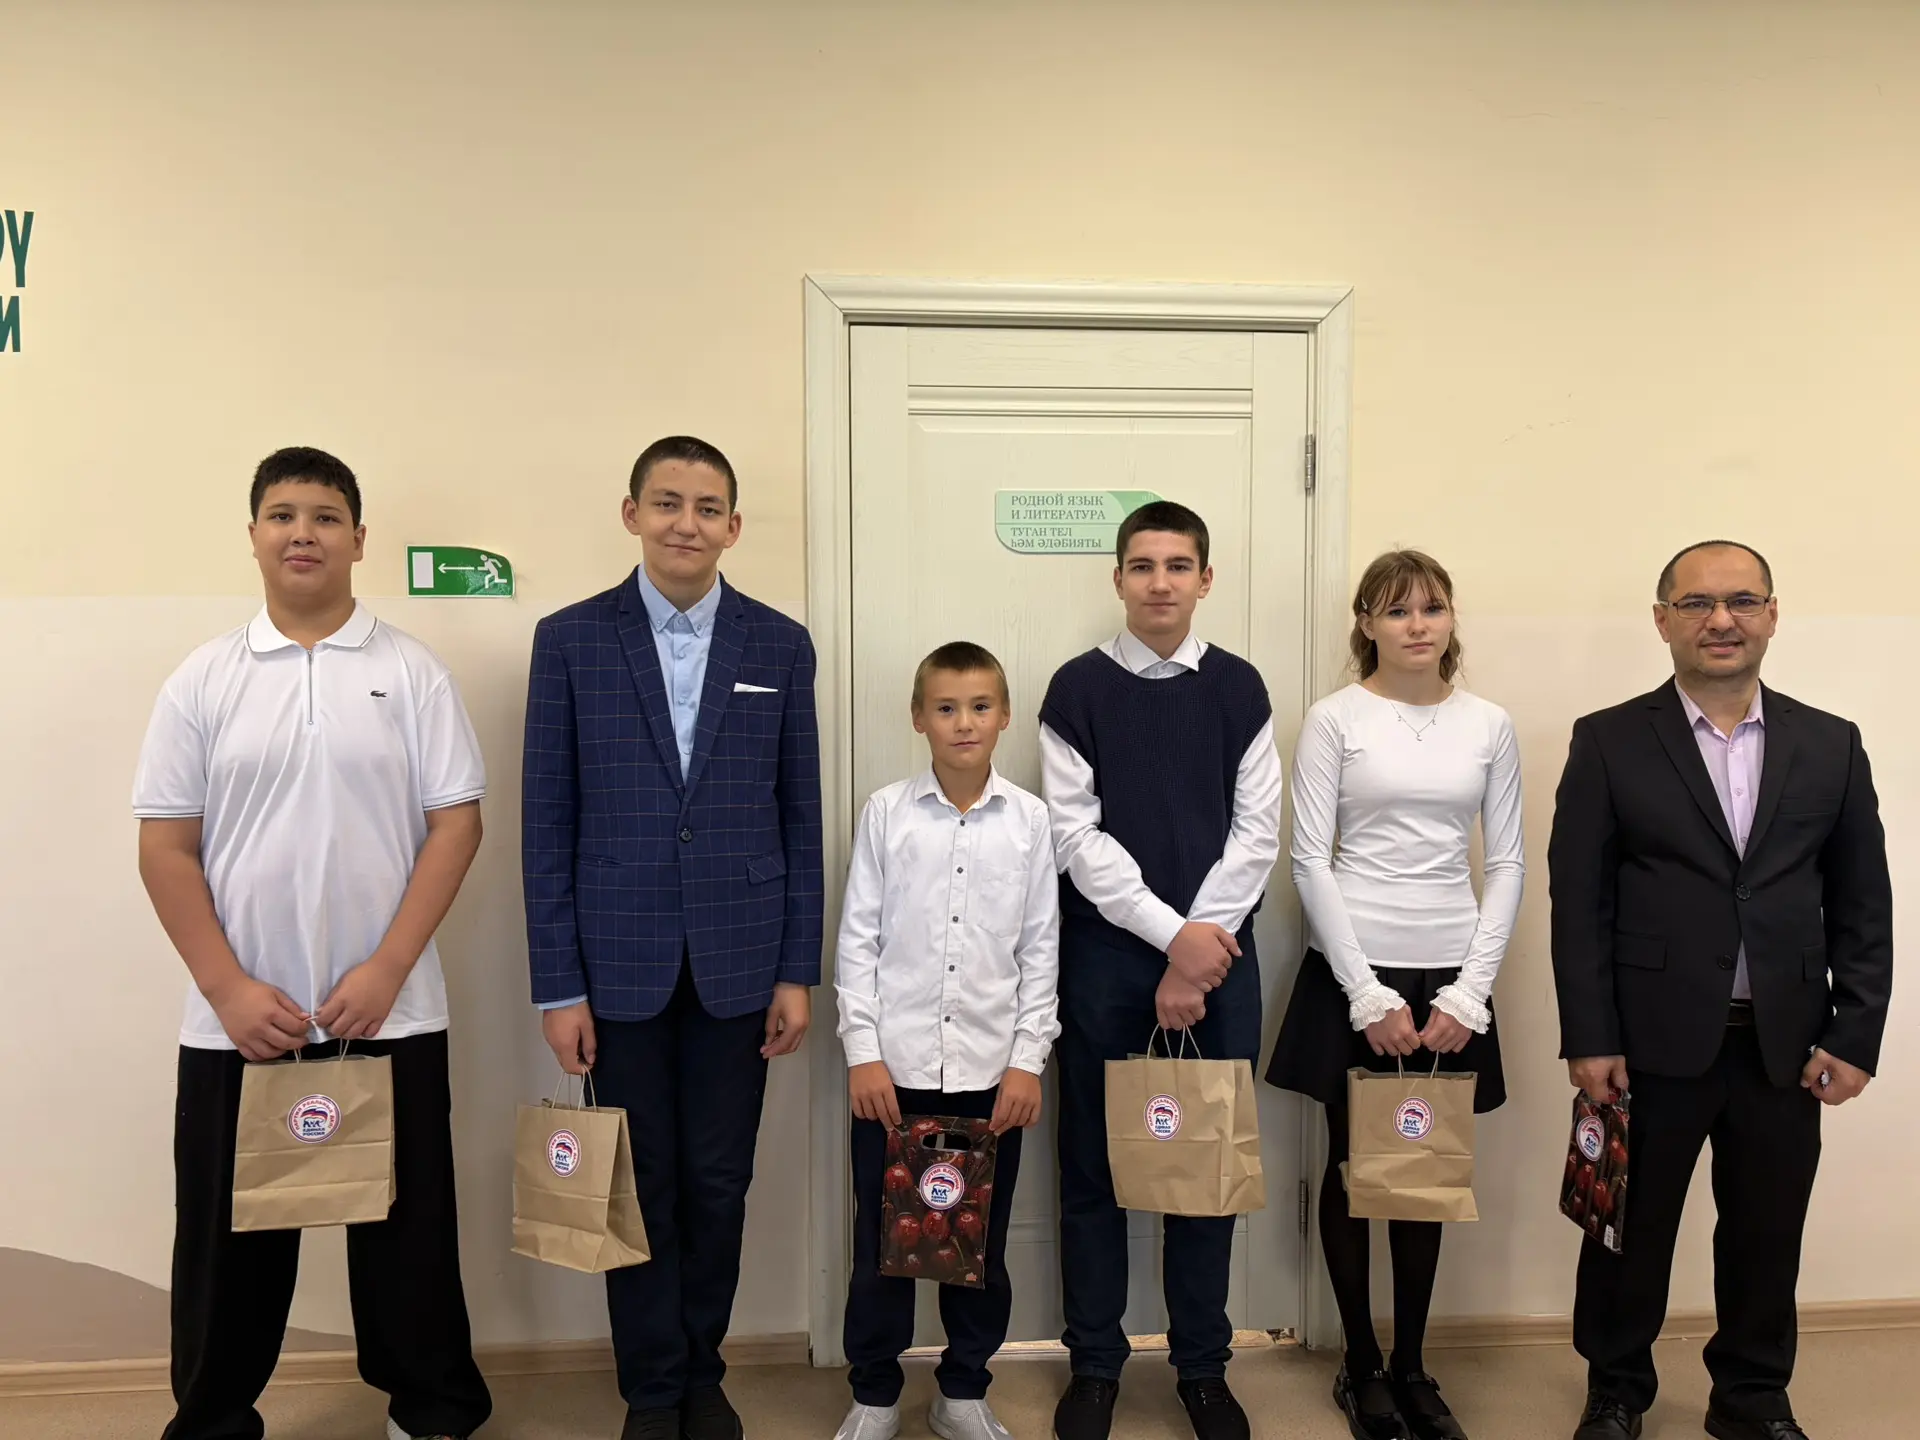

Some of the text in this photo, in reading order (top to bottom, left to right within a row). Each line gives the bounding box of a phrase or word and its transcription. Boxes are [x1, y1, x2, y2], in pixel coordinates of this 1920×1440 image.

[0, 209, 34, 288] У
[1011, 493, 1104, 506] РОДНОЙ ЯЗЫК
[1011, 509, 1106, 521] И ЛИТЕРАТУРА
[1011, 527, 1072, 537] ТУГАН ТЕЛ
[1037, 539, 1102, 549] ӘДӘБИЯТЫ
